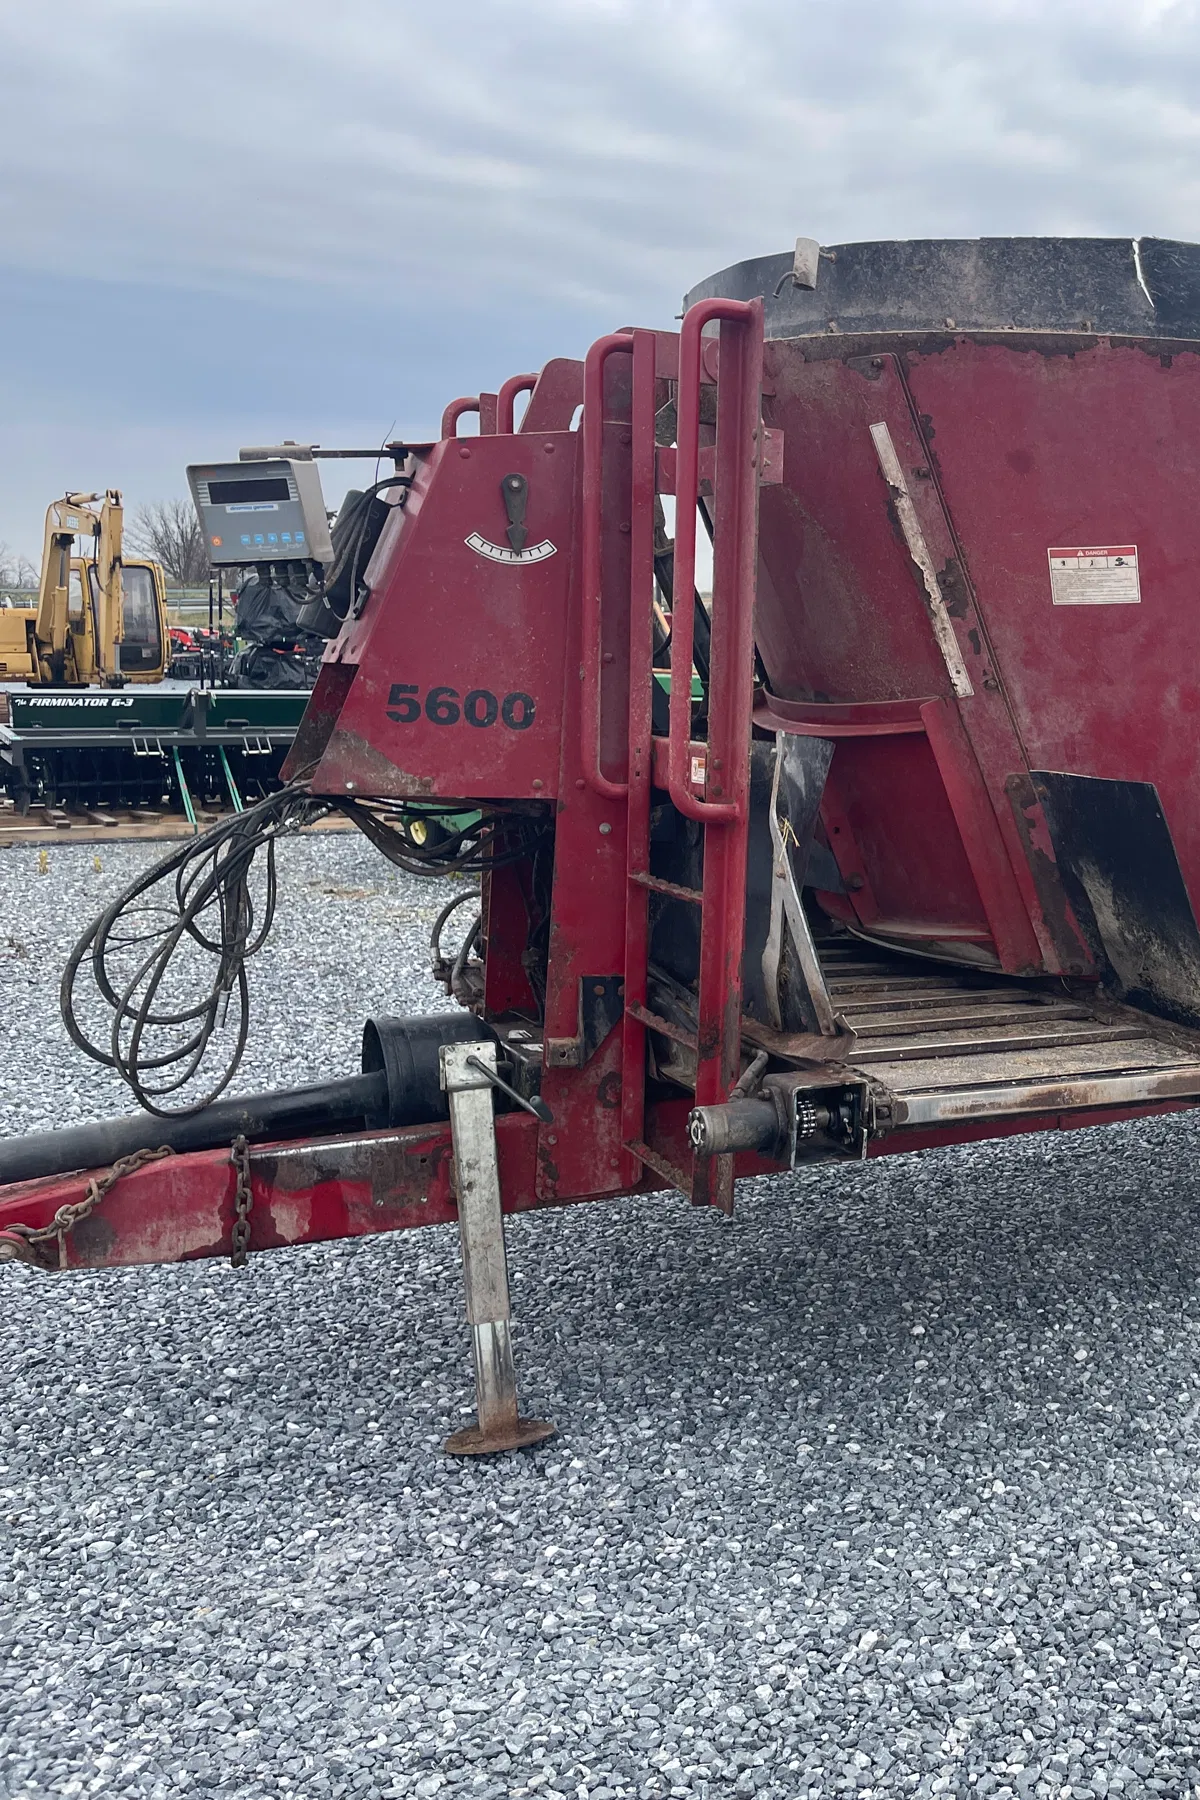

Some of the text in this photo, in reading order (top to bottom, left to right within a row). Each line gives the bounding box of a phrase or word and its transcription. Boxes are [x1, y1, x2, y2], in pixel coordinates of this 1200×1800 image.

[29, 698, 109, 707] FIRMINATOR
[111, 698, 134, 707] G-3
[385, 683, 536, 731] 5600
